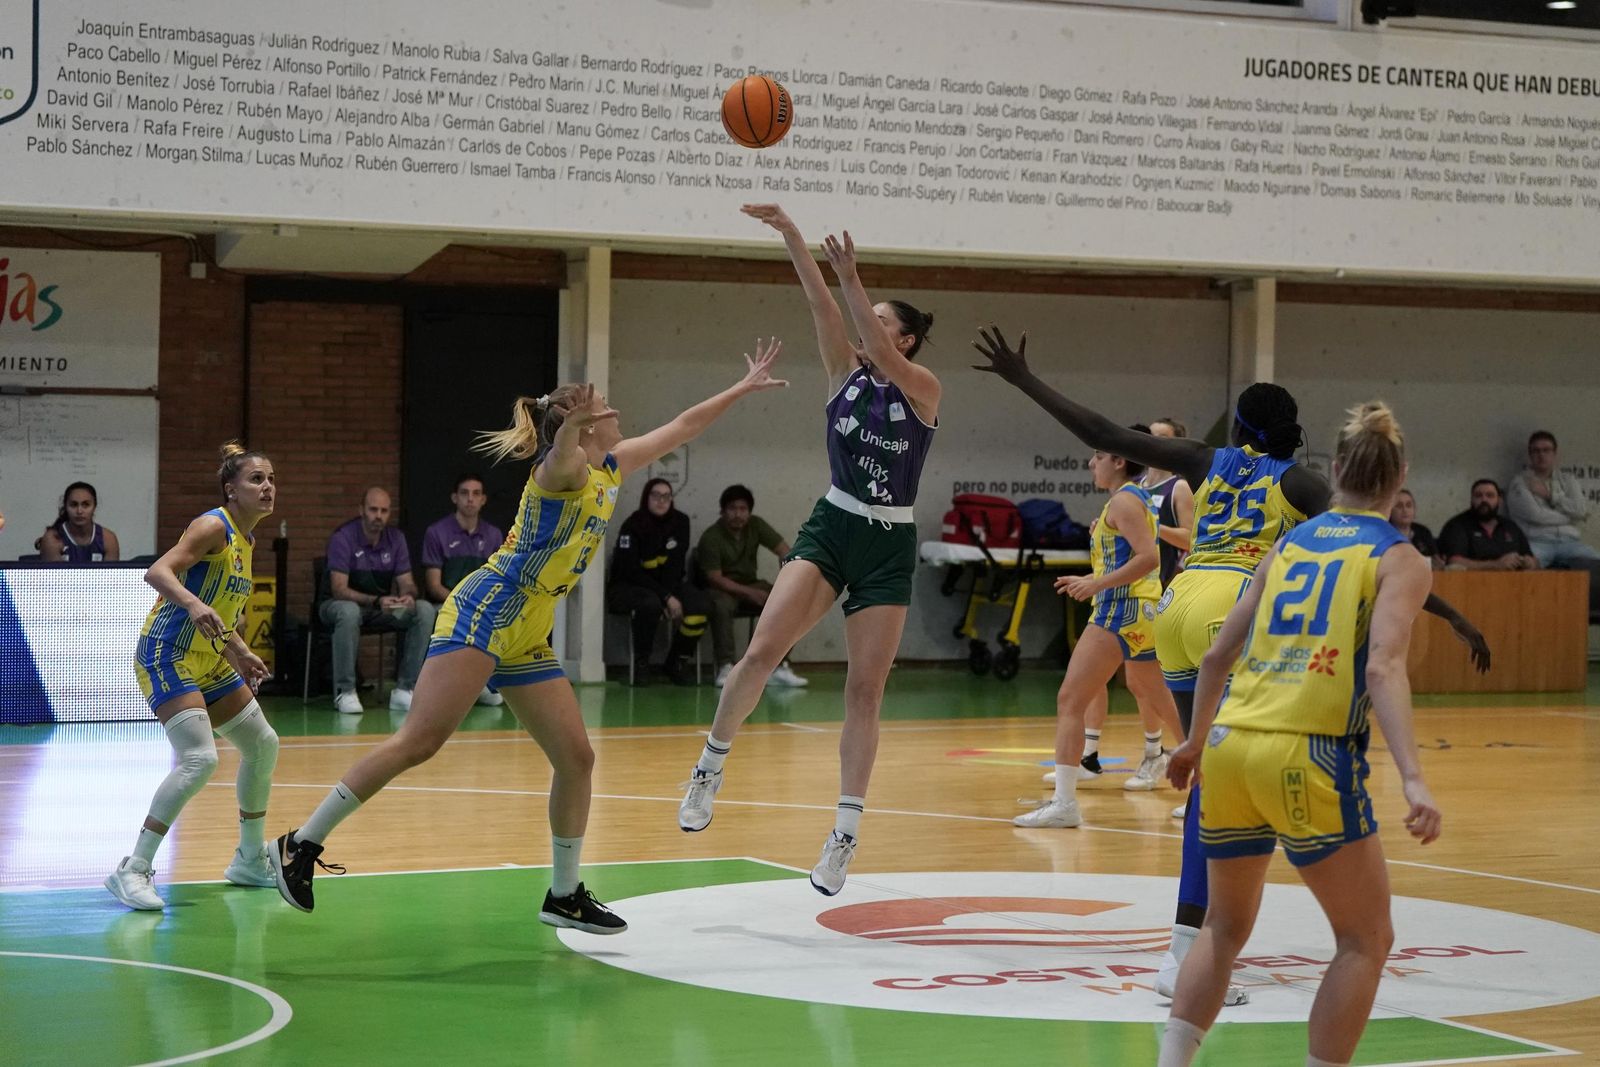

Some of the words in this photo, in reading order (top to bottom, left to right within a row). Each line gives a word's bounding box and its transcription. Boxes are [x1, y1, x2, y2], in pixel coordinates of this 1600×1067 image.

[67, 43, 102, 61] Paco
[108, 46, 160, 65] Cabello
[173, 51, 217, 72] Miguel
[222, 54, 260, 72] Pérez
[273, 58, 322, 76] Alfonso
[326, 61, 370, 79] Portillo
[382, 65, 424, 83] Patrick
[430, 68, 497, 87] Fernández
[509, 74, 545, 90] Pedro
[623, 81, 658, 97] Muriel
[670, 84, 708, 103] Miguel
[822, 94, 858, 112] Miguel
[139, 23, 254, 49] Entrambasaguas
[268, 32, 306, 50] Julián
[392, 41, 438, 59] Manolo
[444, 45, 480, 62] Rubia
[492, 48, 527, 65] Salva
[532, 51, 568, 68] Gallar
[580, 54, 636, 72] Bernardo
[714, 64, 743, 79] Paco
[792, 69, 827, 85] Llorca
[886, 75, 930, 91] Caneda
[1244, 57, 1351, 83] JUGADORES
[1358, 65, 1381, 84] DE
[1386, 66, 1468, 90] CANTERA
[1473, 72, 1509, 94] QUE
[1514, 74, 1551, 94] HAN
[47, 89, 88, 107] David
[93, 92, 112, 109] Gil
[127, 94, 178, 113] Manolo
[183, 97, 222, 115] Pérez
[237, 101, 280, 119] Rubén
[286, 104, 322, 125] Mayo
[335, 107, 396, 127] Alejandro
[402, 111, 430, 127] Alba
[442, 113, 493, 131] Germán
[498, 117, 544, 134] Gabriel
[556, 120, 590, 136] Manu
[595, 122, 638, 139] Gómez
[651, 126, 689, 142] Carlos
[694, 128, 736, 144] Cabez
[863, 138, 904, 153] Francis
[57, 66, 111, 85] Antonio
[182, 74, 215, 92] José
[220, 77, 274, 95] Torrubia
[288, 81, 330, 99] Rafael
[336, 84, 379, 102] Ibáñez
[392, 88, 422, 104] José
[448, 91, 472, 107] Mur
[486, 94, 540, 111] Cristóbal
[601, 101, 636, 117] Pedro
[641, 103, 671, 119] Bello
[683, 106, 721, 122] Ricard
[792, 112, 818, 128] Juan
[823, 114, 857, 130] Matito
[868, 117, 910, 133] Antonio
[27, 136, 66, 154] Pablo
[72, 138, 132, 157] Sánchez
[146, 142, 196, 164] Morgan
[202, 145, 242, 163] Stilma
[256, 148, 294, 166] Lucas
[300, 151, 343, 168] Muñoz
[355, 154, 396, 171] Rubén
[402, 156, 458, 174] Guerrero
[470, 160, 510, 177] Ismael
[516, 162, 555, 179] Tamba
[567, 165, 611, 182] Francis
[614, 168, 654, 184] Alonso
[666, 170, 711, 187] Yannick
[716, 173, 751, 189] Nzosa
[763, 176, 789, 191] Rafa
[793, 177, 832, 193] Santos
[846, 180, 878, 195] Mario
[37, 112, 66, 129] Miki
[72, 114, 128, 133] Servera
[144, 118, 176, 136] Rafa
[182, 121, 223, 138] Freire
[237, 124, 294, 145] Augusto
[300, 128, 332, 145] Lima
[346, 130, 382, 147] Pablo
[388, 133, 444, 151] Almazán
[458, 137, 500, 154] Carlos
[505, 139, 520, 155] de
[526, 141, 566, 157] Cobos
[580, 144, 612, 163] Pepe
[616, 146, 654, 162] Pozas
[666, 149, 710, 165] Alberto
[783, 155, 828, 171] Abrines
[841, 158, 864, 173] Luis
[868, 160, 906, 175] Conde
[859, 428, 910, 455] Unicaja
[1033, 455, 1079, 471] Puedo
[952, 480, 986, 495] pero
[989, 481, 1007, 493] no
[1011, 479, 1055, 495] puedo
[1196, 487, 1268, 545] 25
[1313, 526, 1361, 539] ROTERS
[1267, 559, 1345, 637] 21
[1286, 771, 1306, 822] MTC
[872, 963, 1161, 991] COSTA
